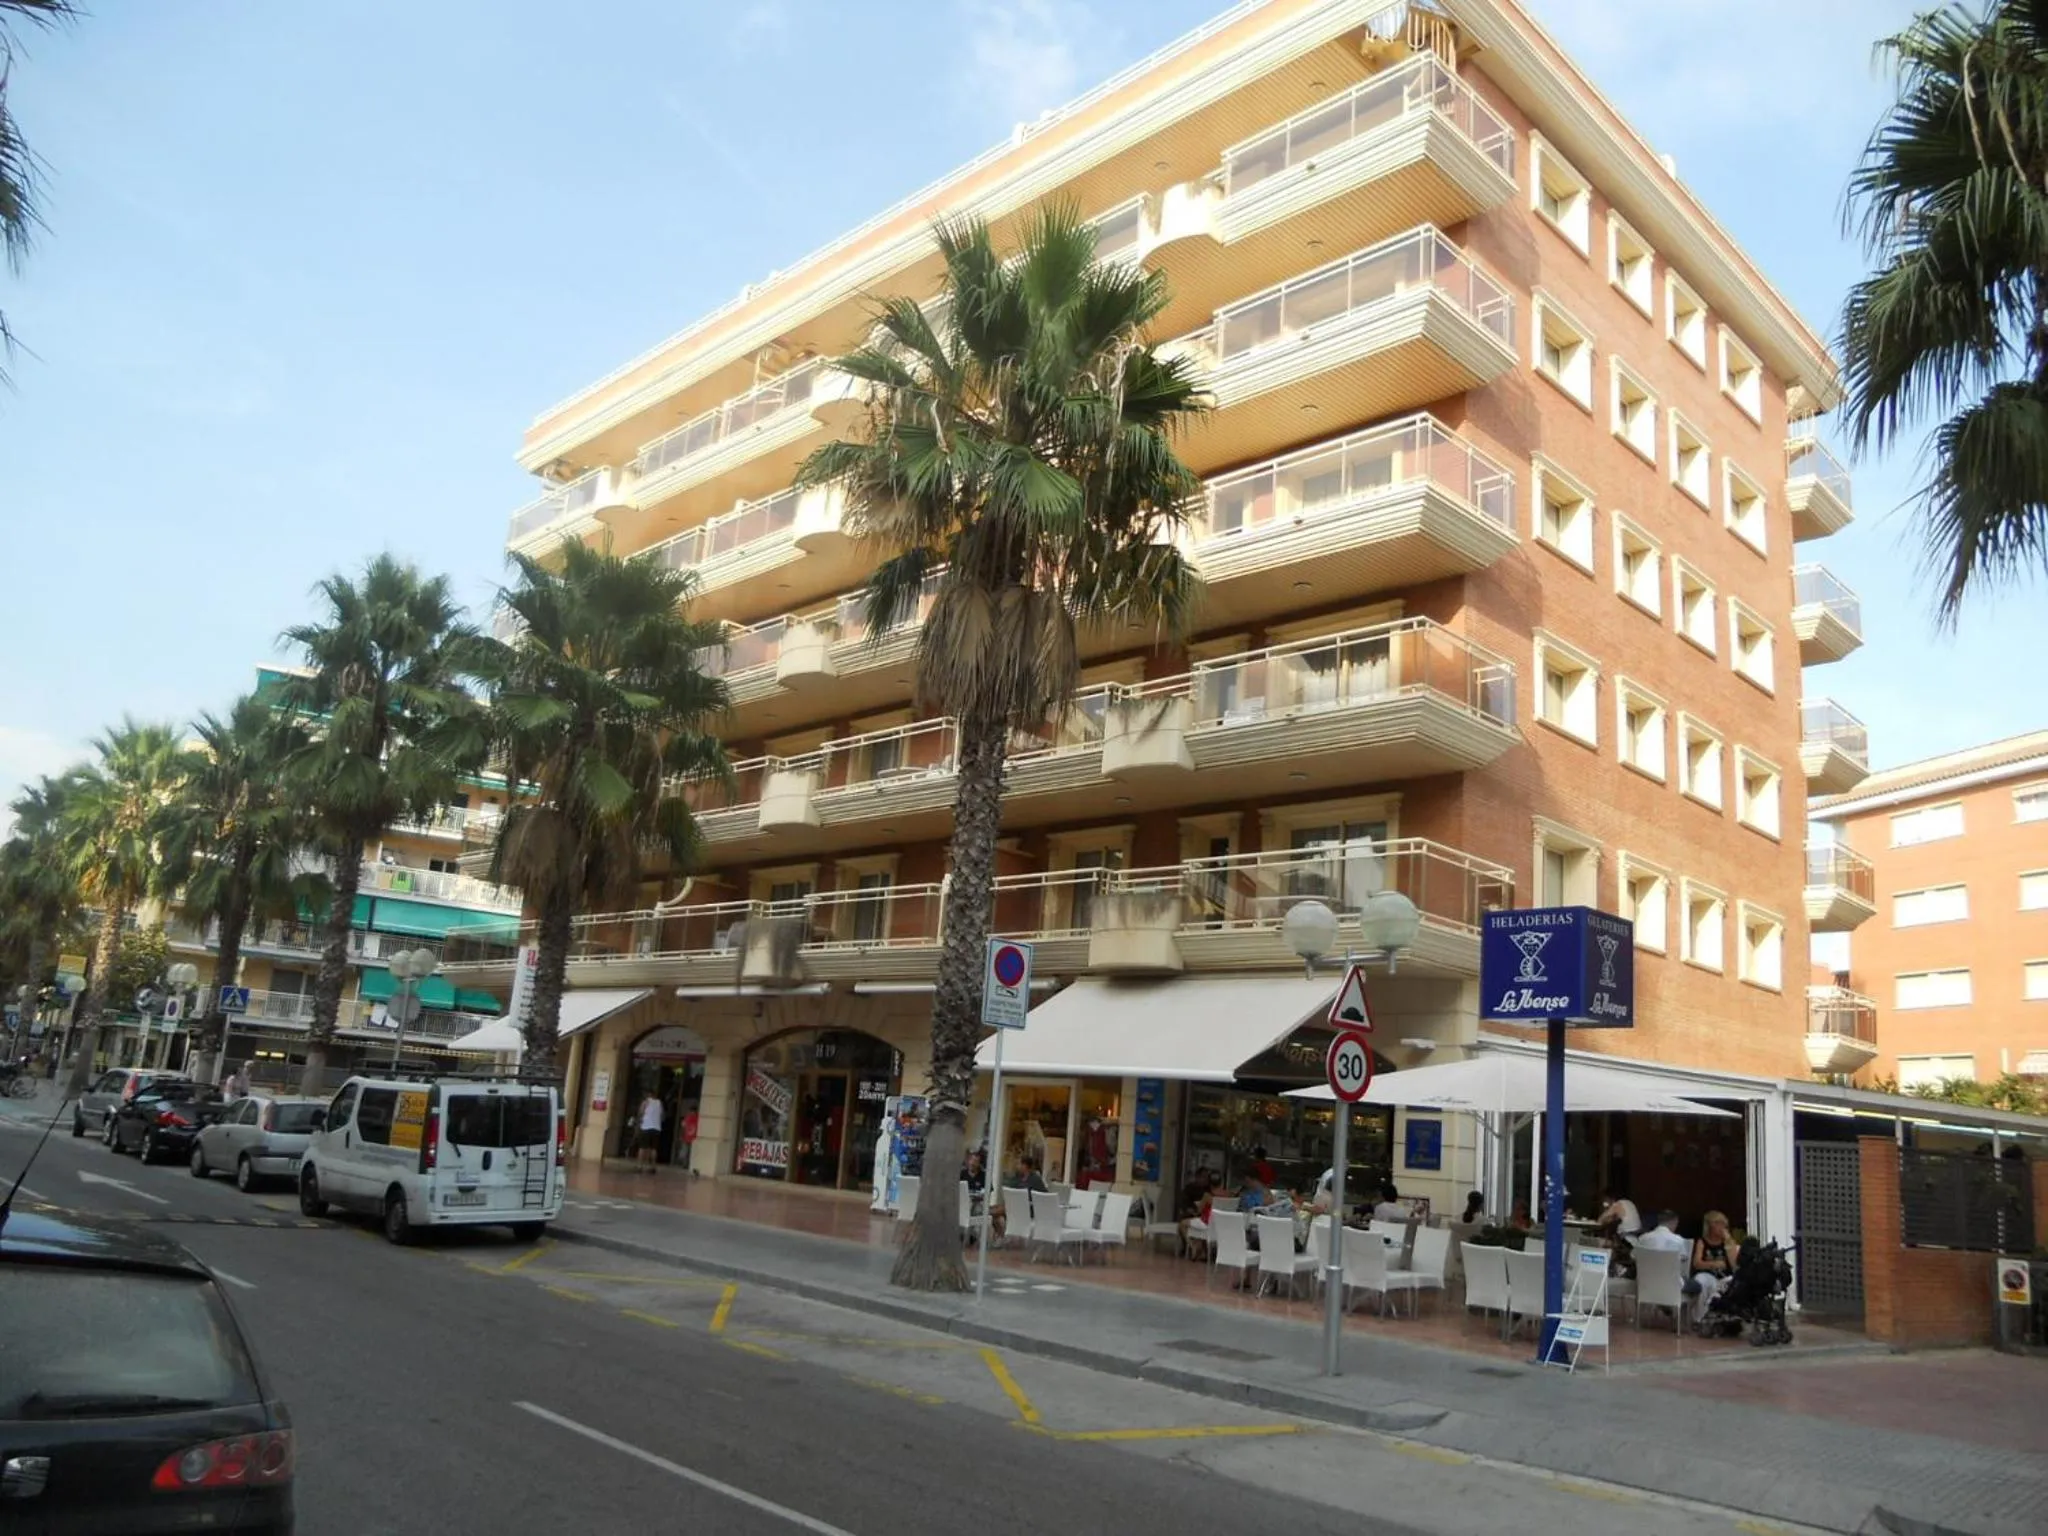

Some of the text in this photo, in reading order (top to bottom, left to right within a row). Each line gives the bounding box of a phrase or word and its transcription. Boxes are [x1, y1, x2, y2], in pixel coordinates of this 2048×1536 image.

[1491, 912, 1574, 928] HELADERIAS
[1493, 990, 1517, 1012] La
[1338, 1053, 1363, 1080] 30
[743, 1140, 789, 1165] REBAJAS
